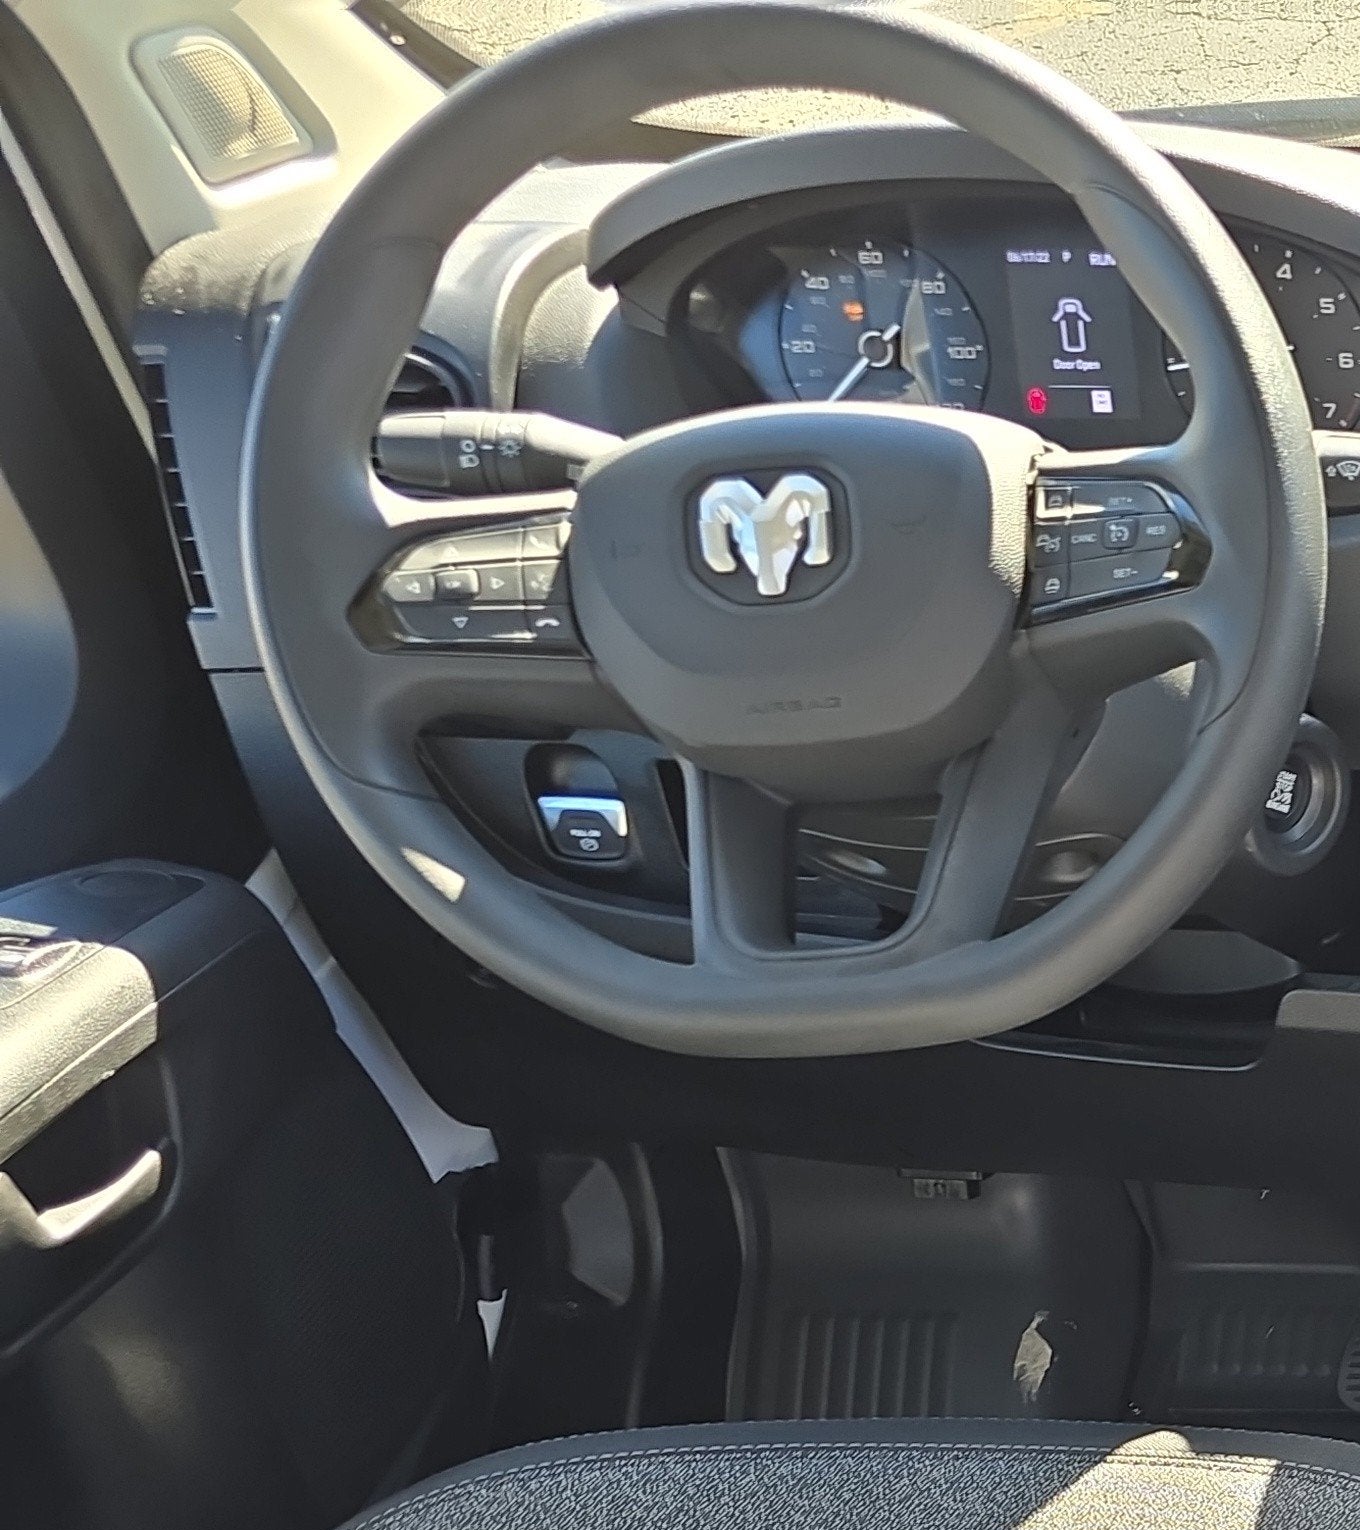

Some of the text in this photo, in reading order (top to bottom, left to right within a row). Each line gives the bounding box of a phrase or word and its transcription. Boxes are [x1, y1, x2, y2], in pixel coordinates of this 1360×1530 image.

[858, 251, 883, 264] 60
[1275, 263, 1293, 280] 4
[805, 277, 830, 290] 40
[921, 281, 946, 294] 80
[1318, 298, 1336, 314] 5
[790, 340, 816, 353] 20
[947, 347, 977, 360] 100
[1338, 353, 1355, 369] 6
[1322, 403, 1337, 419] 7
